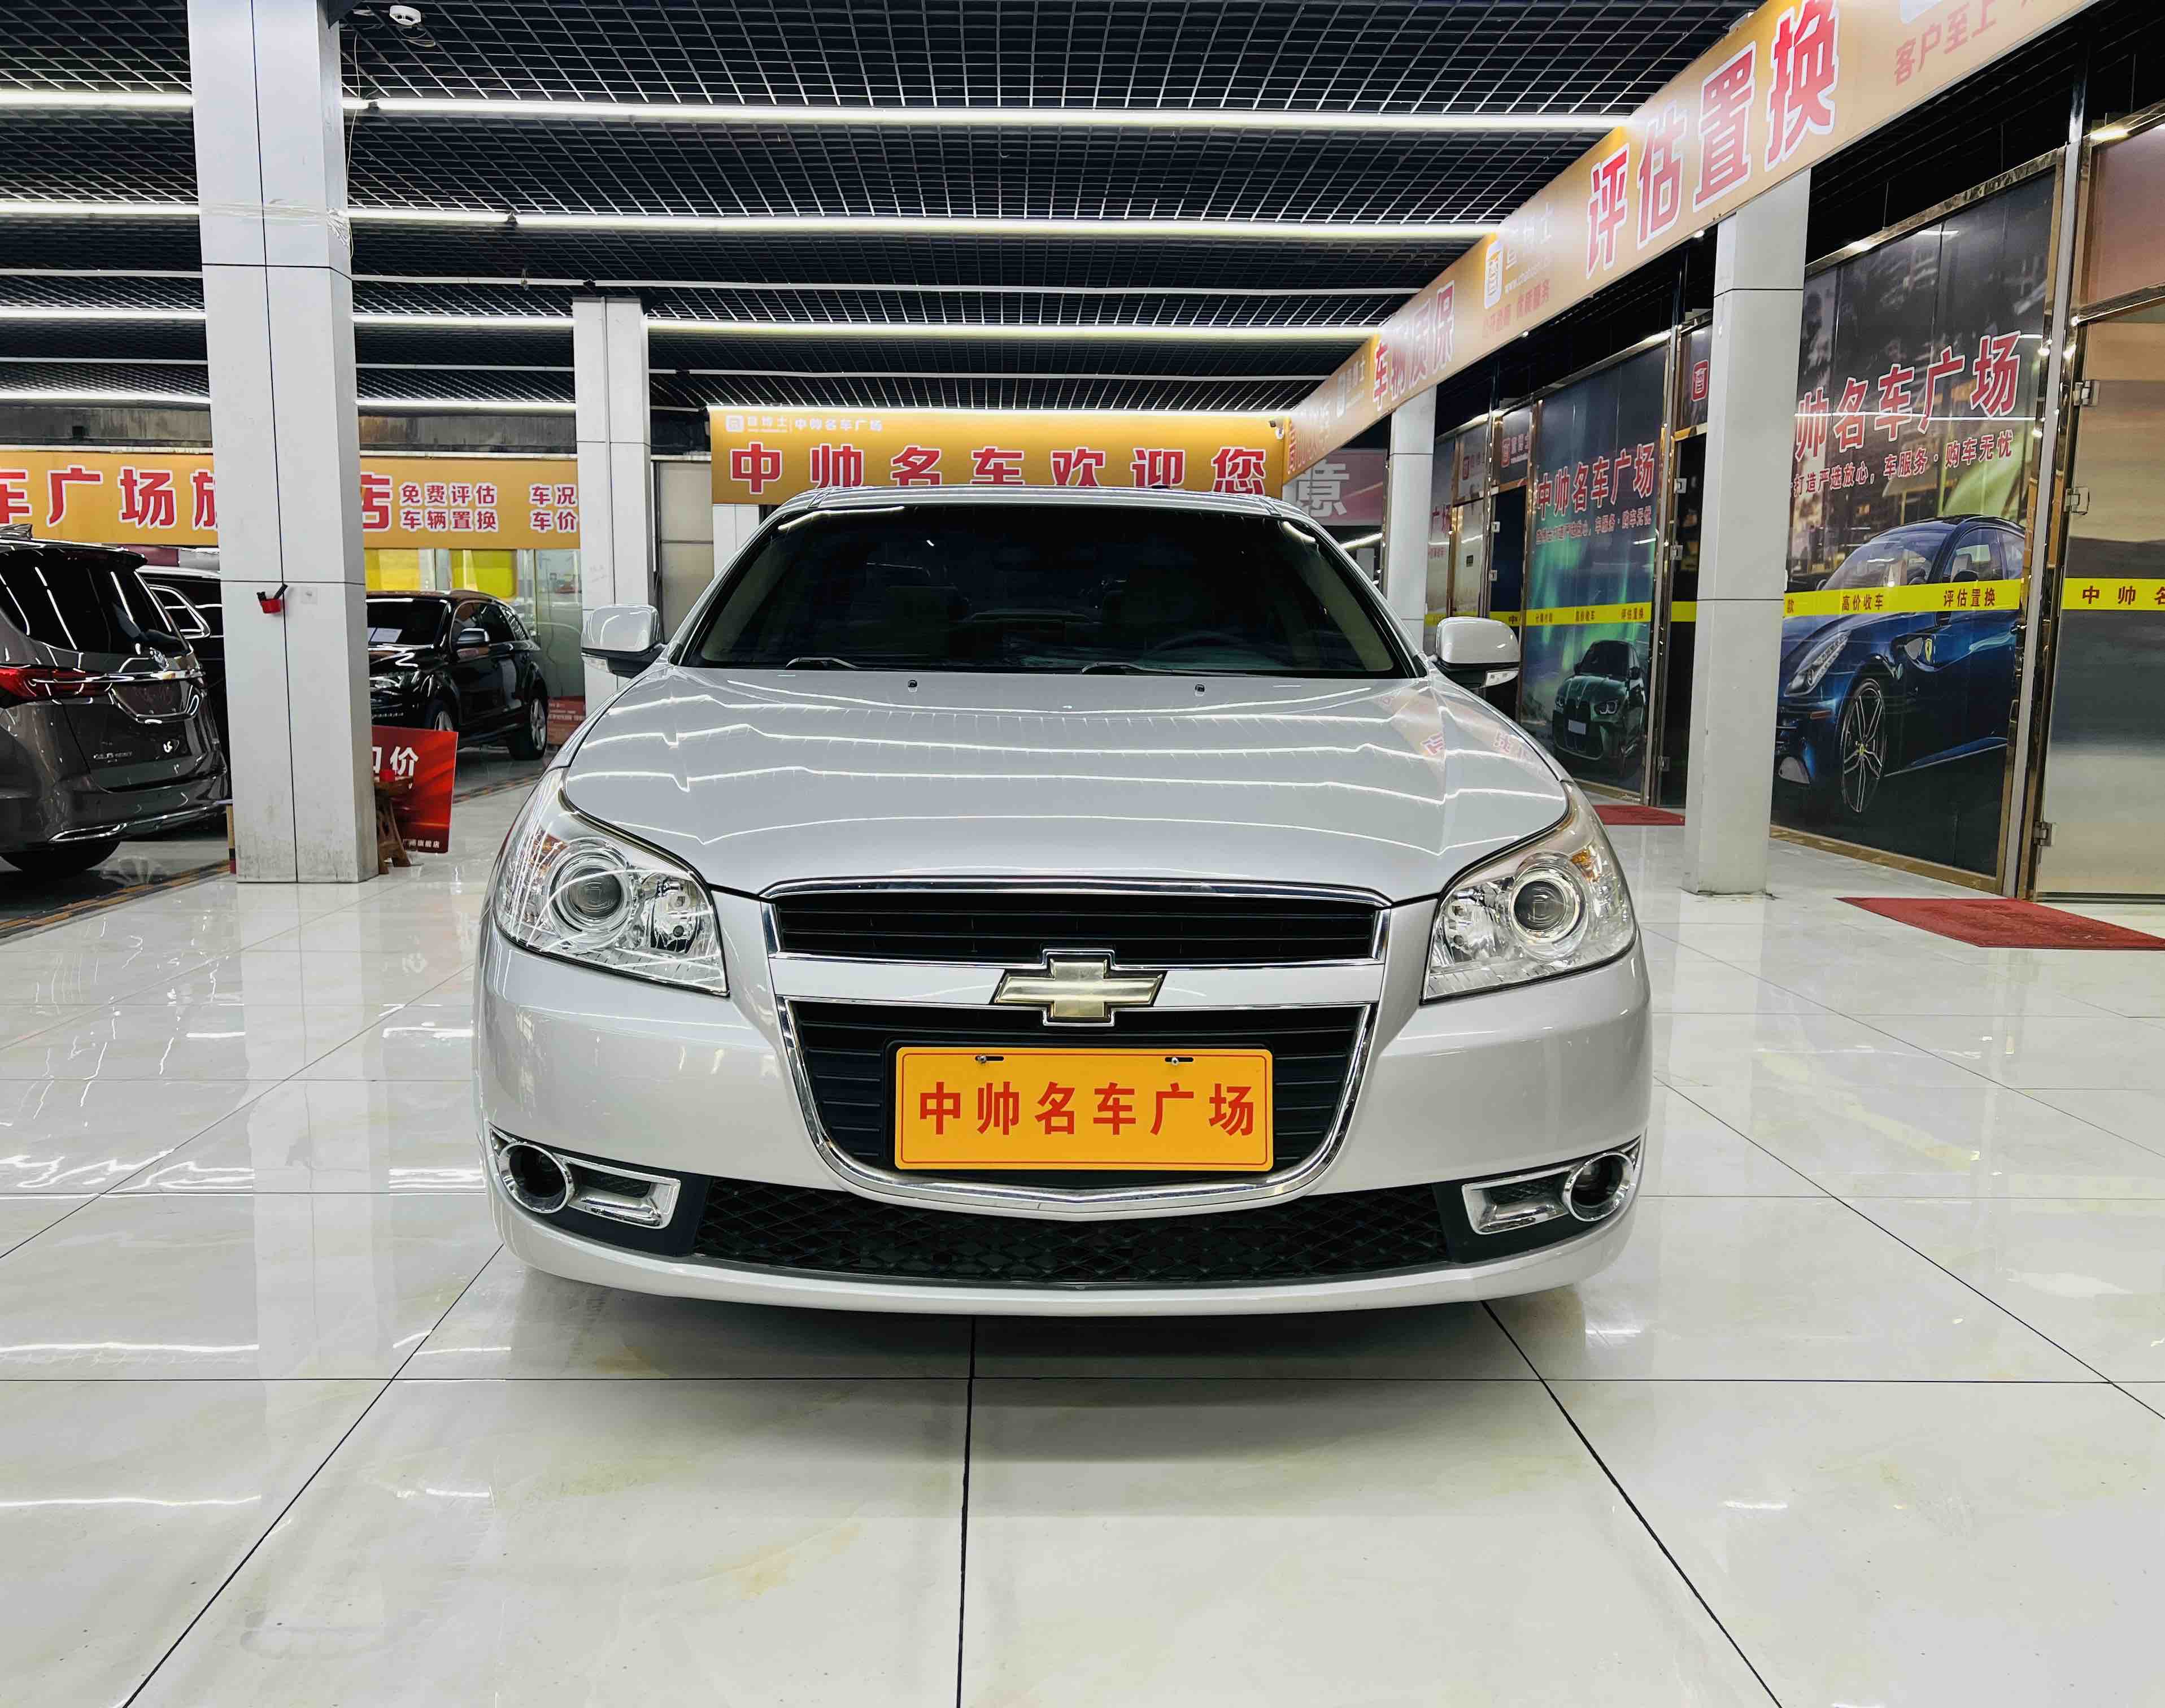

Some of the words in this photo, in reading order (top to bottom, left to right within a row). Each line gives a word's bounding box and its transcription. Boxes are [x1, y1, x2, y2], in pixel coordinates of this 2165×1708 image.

[1586, 0, 1840, 280] 评估置换
[1794, 330, 2022, 461] 帅名车广场
[401, 484, 496, 505] 免费评估
[531, 485, 576, 505] 车况
[730, 442, 1266, 495] 中帅名车欢迎您
[1537, 442, 1655, 521] 中帅名车广场
[402, 509, 497, 530] 车辆置换
[532, 511, 576, 530] 车价
[1841, 594, 1885, 611] 高价收车
[1943, 587, 1996, 607] 评估置换
[918, 1081, 1255, 1136] 中帅名车广场
